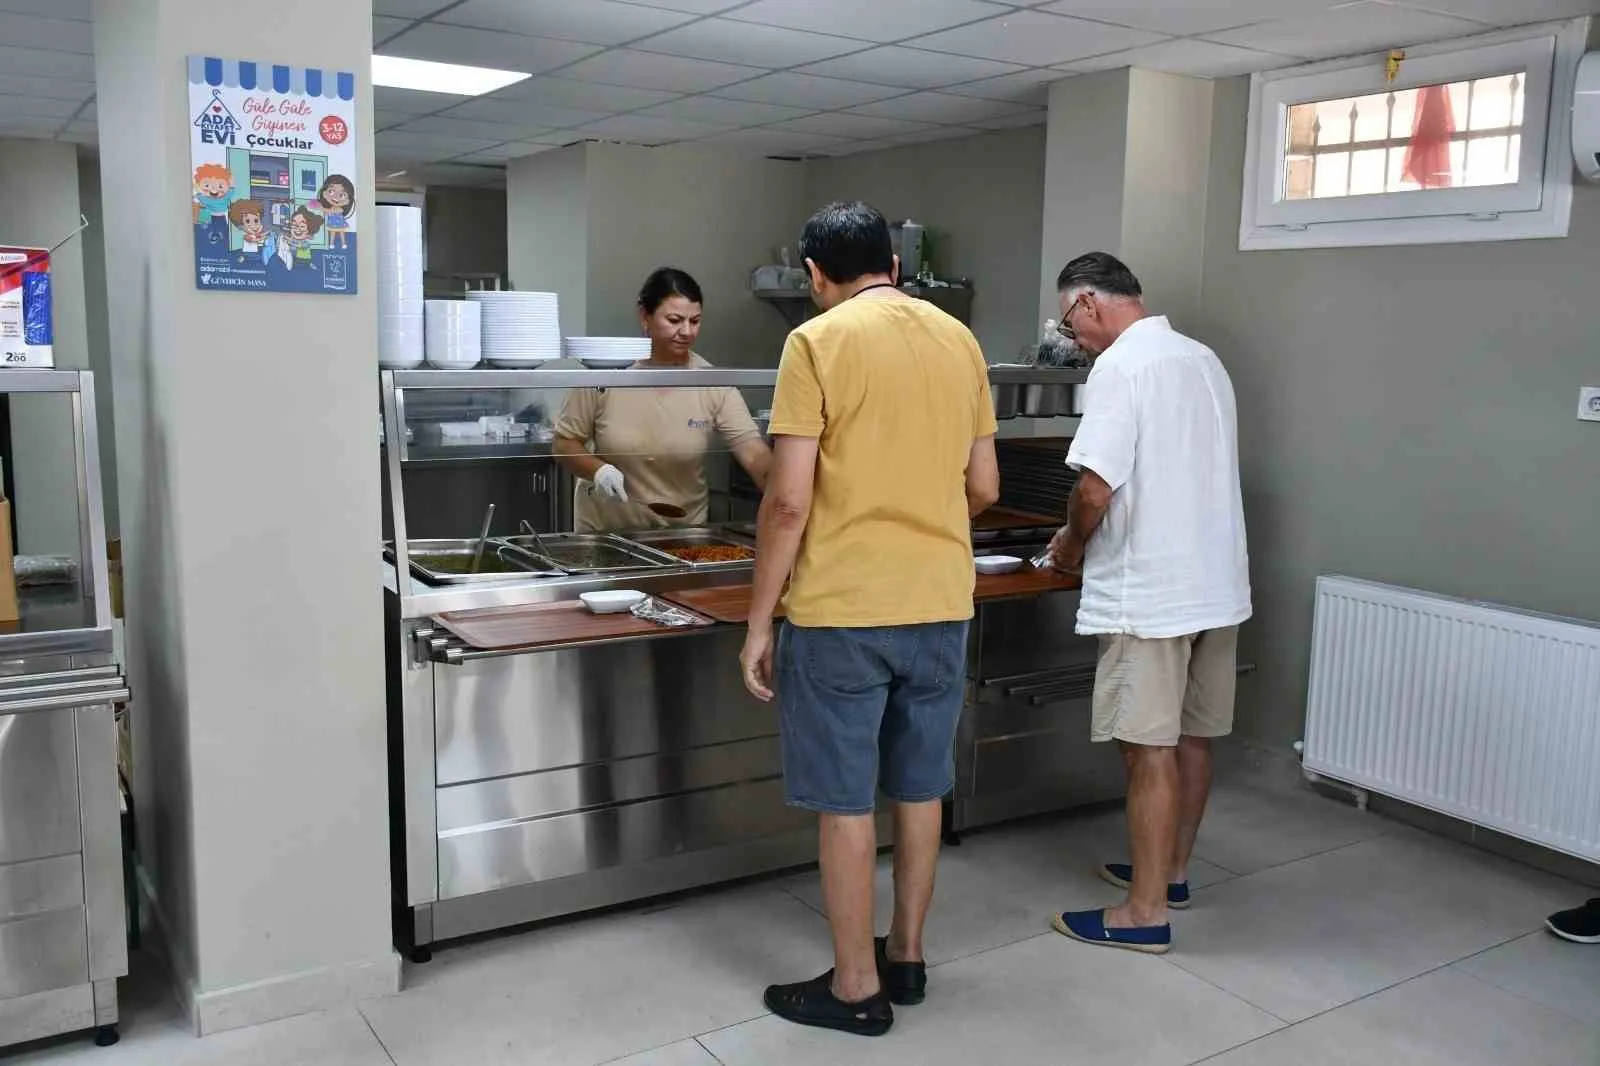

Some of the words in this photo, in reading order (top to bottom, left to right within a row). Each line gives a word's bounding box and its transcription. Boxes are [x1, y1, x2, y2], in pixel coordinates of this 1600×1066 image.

[201, 114, 235, 125] ADA
[321, 122, 345, 133] 3-12
[246, 134, 314, 150] Çocuklar
